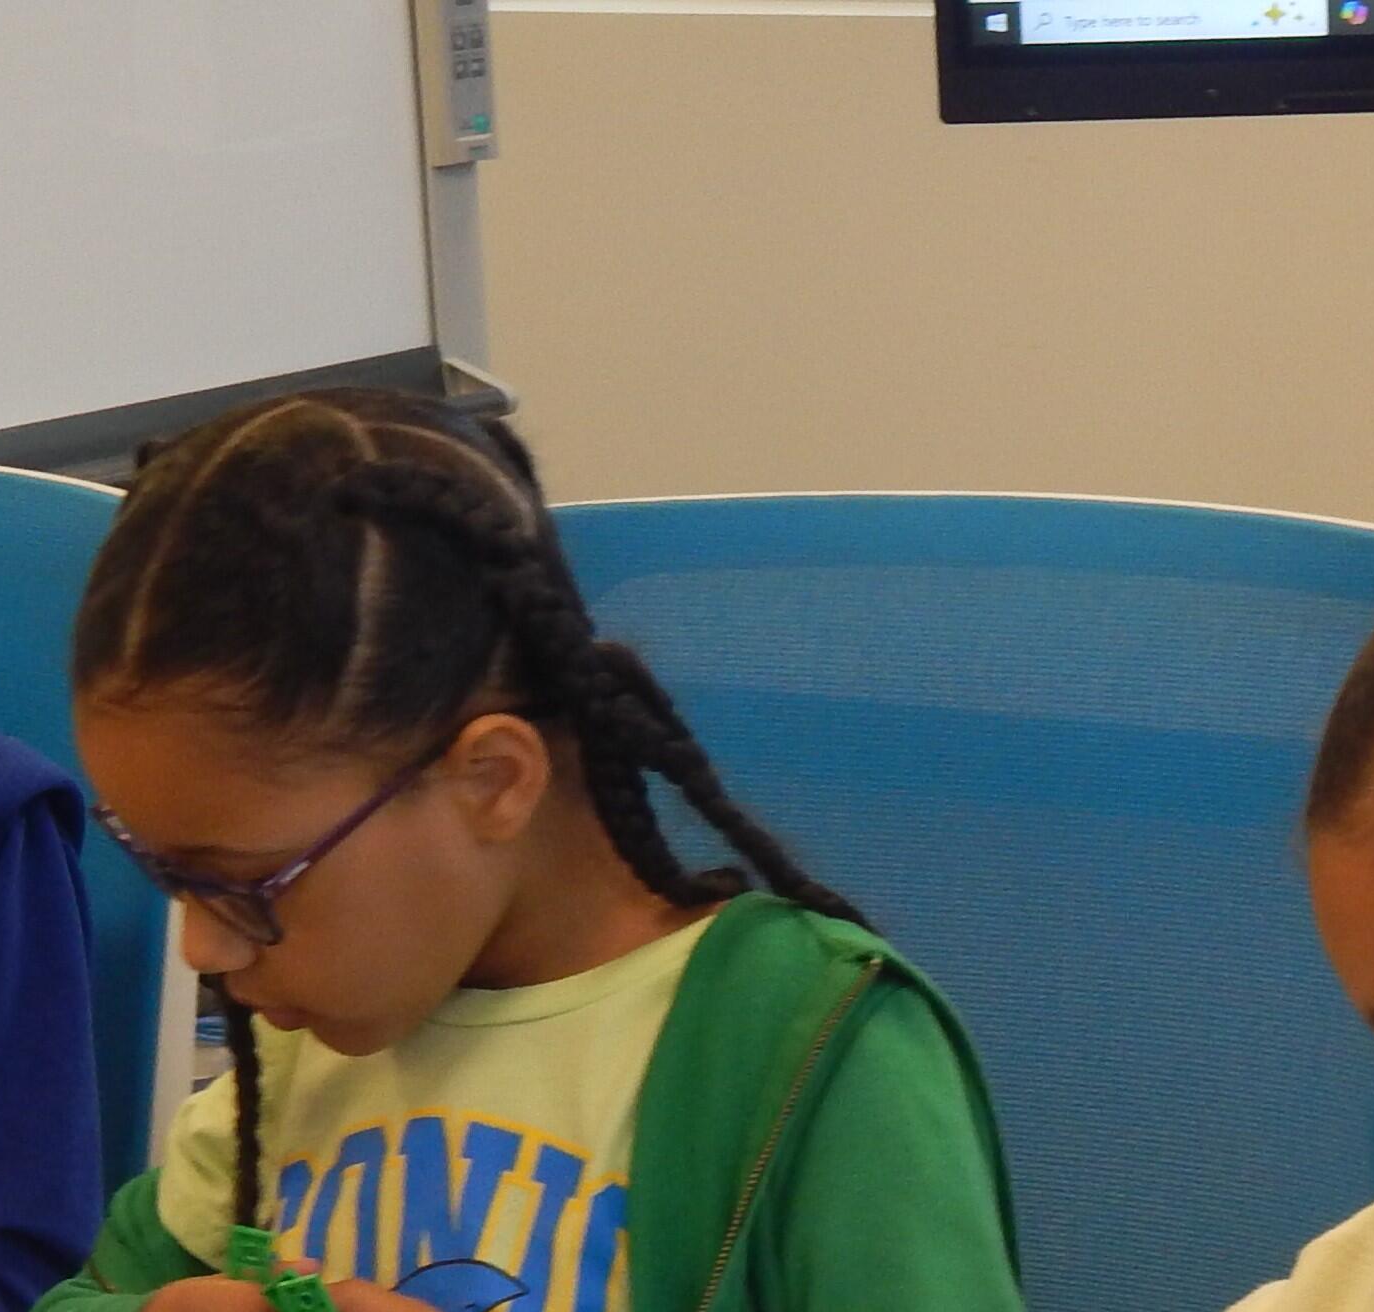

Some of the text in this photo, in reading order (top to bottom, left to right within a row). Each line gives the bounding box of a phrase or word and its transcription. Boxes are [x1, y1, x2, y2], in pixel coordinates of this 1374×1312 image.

[1063, 11, 1202, 32] Type here to search
